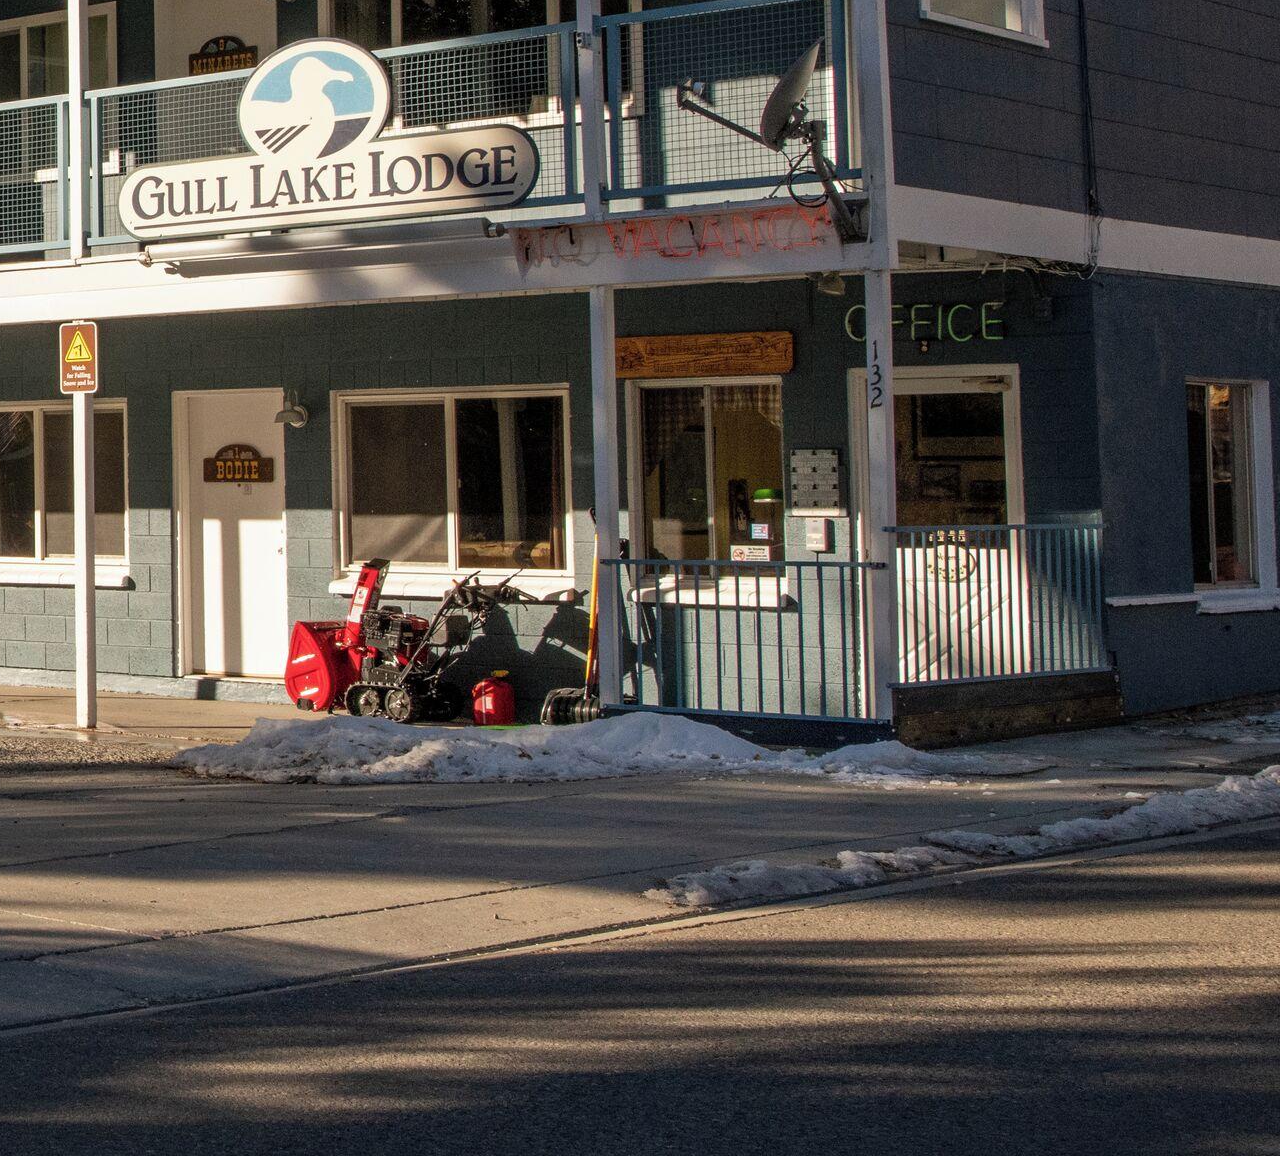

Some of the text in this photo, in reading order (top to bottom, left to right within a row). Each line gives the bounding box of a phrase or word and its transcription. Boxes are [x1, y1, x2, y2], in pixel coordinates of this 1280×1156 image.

[193, 52, 253, 75] MINARETS
[131, 145, 519, 220] GULL LAKE LODGE
[605, 205, 833, 259] VACANCY
[870, 340, 883, 409] 132
[215, 460, 259, 479] BODIE
[234, 447, 239, 459] 1
